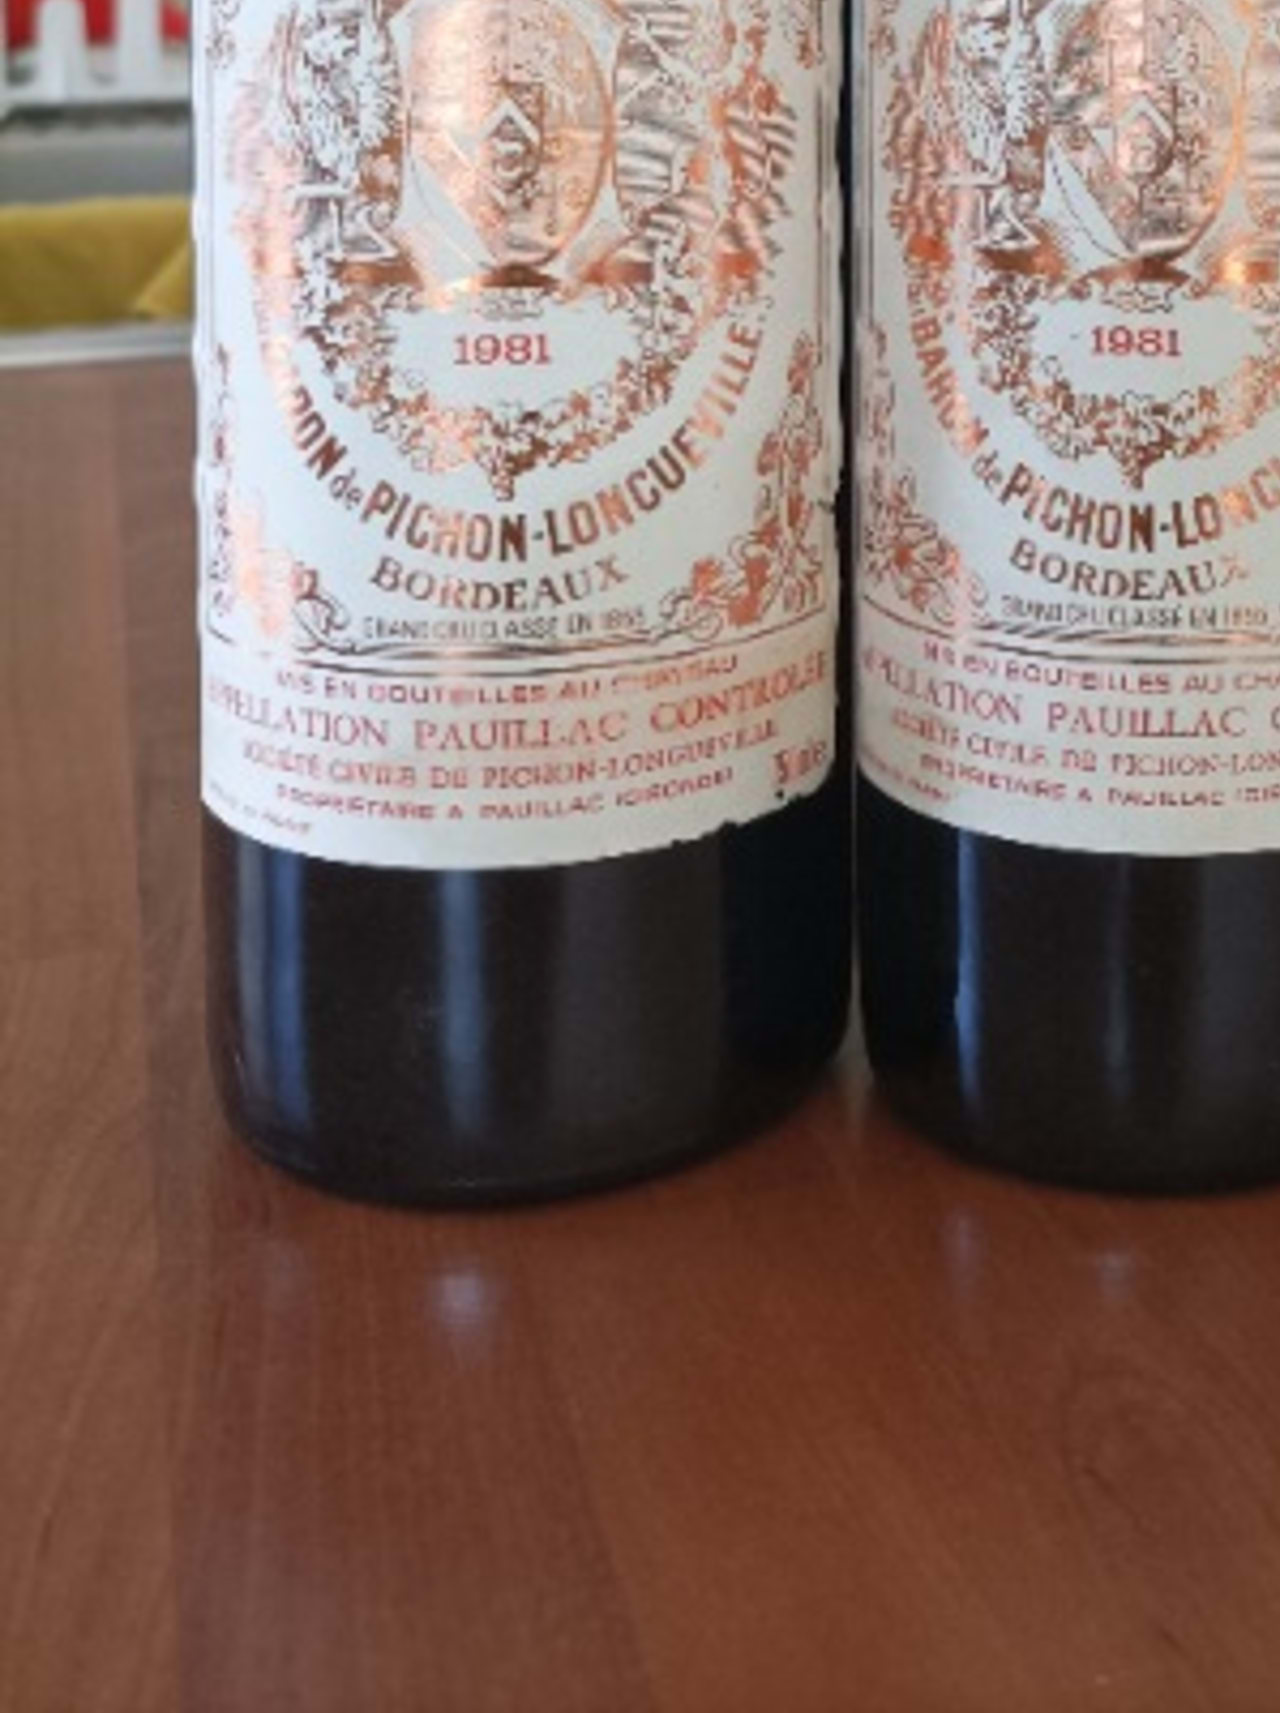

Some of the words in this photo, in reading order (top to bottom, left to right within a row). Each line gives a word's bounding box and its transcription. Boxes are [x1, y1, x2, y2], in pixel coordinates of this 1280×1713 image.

[453, 334, 553, 365] 1981
[1090, 325, 1182, 358] 1981
[329, 467, 363, 510] de
[368, 554, 628, 613] BORDEAUX
[1009, 538, 1252, 601] BORDEAUX
[414, 711, 628, 751] PAUILLAC
[1047, 701, 1249, 739] PAUILLAC
